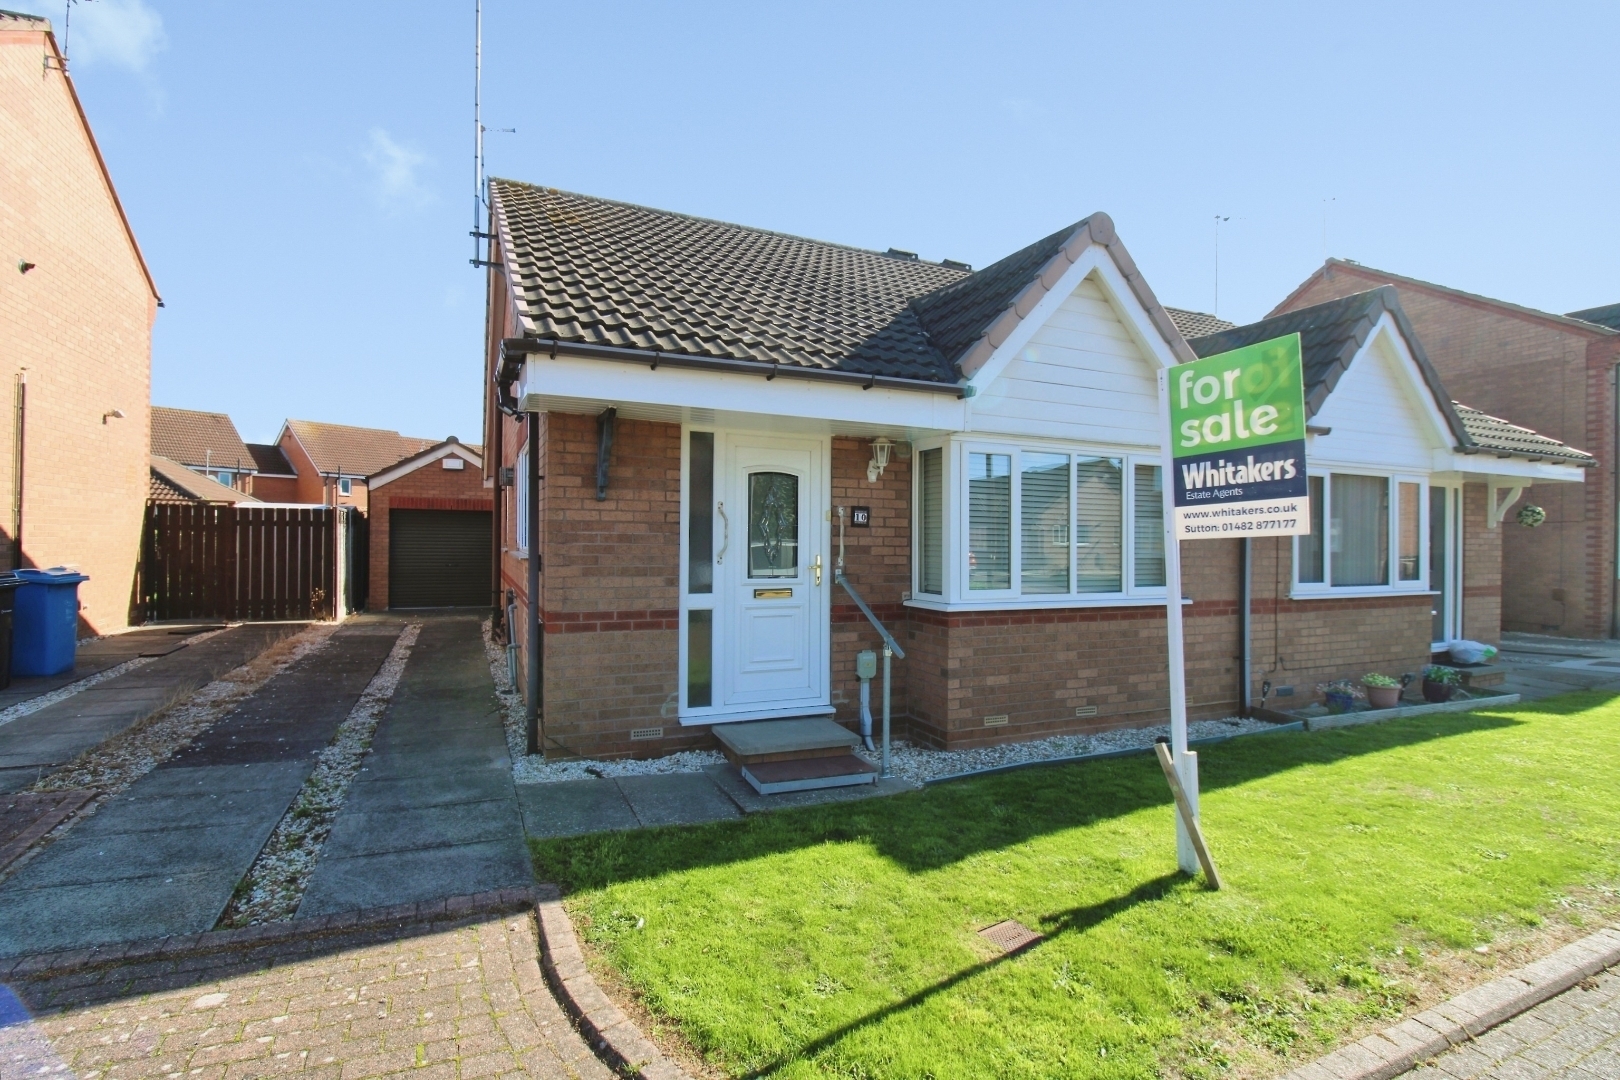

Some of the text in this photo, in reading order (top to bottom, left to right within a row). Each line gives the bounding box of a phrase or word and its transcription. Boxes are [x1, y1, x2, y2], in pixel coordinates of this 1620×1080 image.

[1179, 368, 1241, 410] for
[1180, 399, 1279, 448] sale
[1181, 455, 1297, 490] Whitakers
[1185, 487, 1244, 500] Estate Agents
[855, 513, 867, 521] 10
[1183, 503, 1298, 519] www.whitakers.co.uk
[1184, 519, 1297, 533] Sutton: 01482 877177
